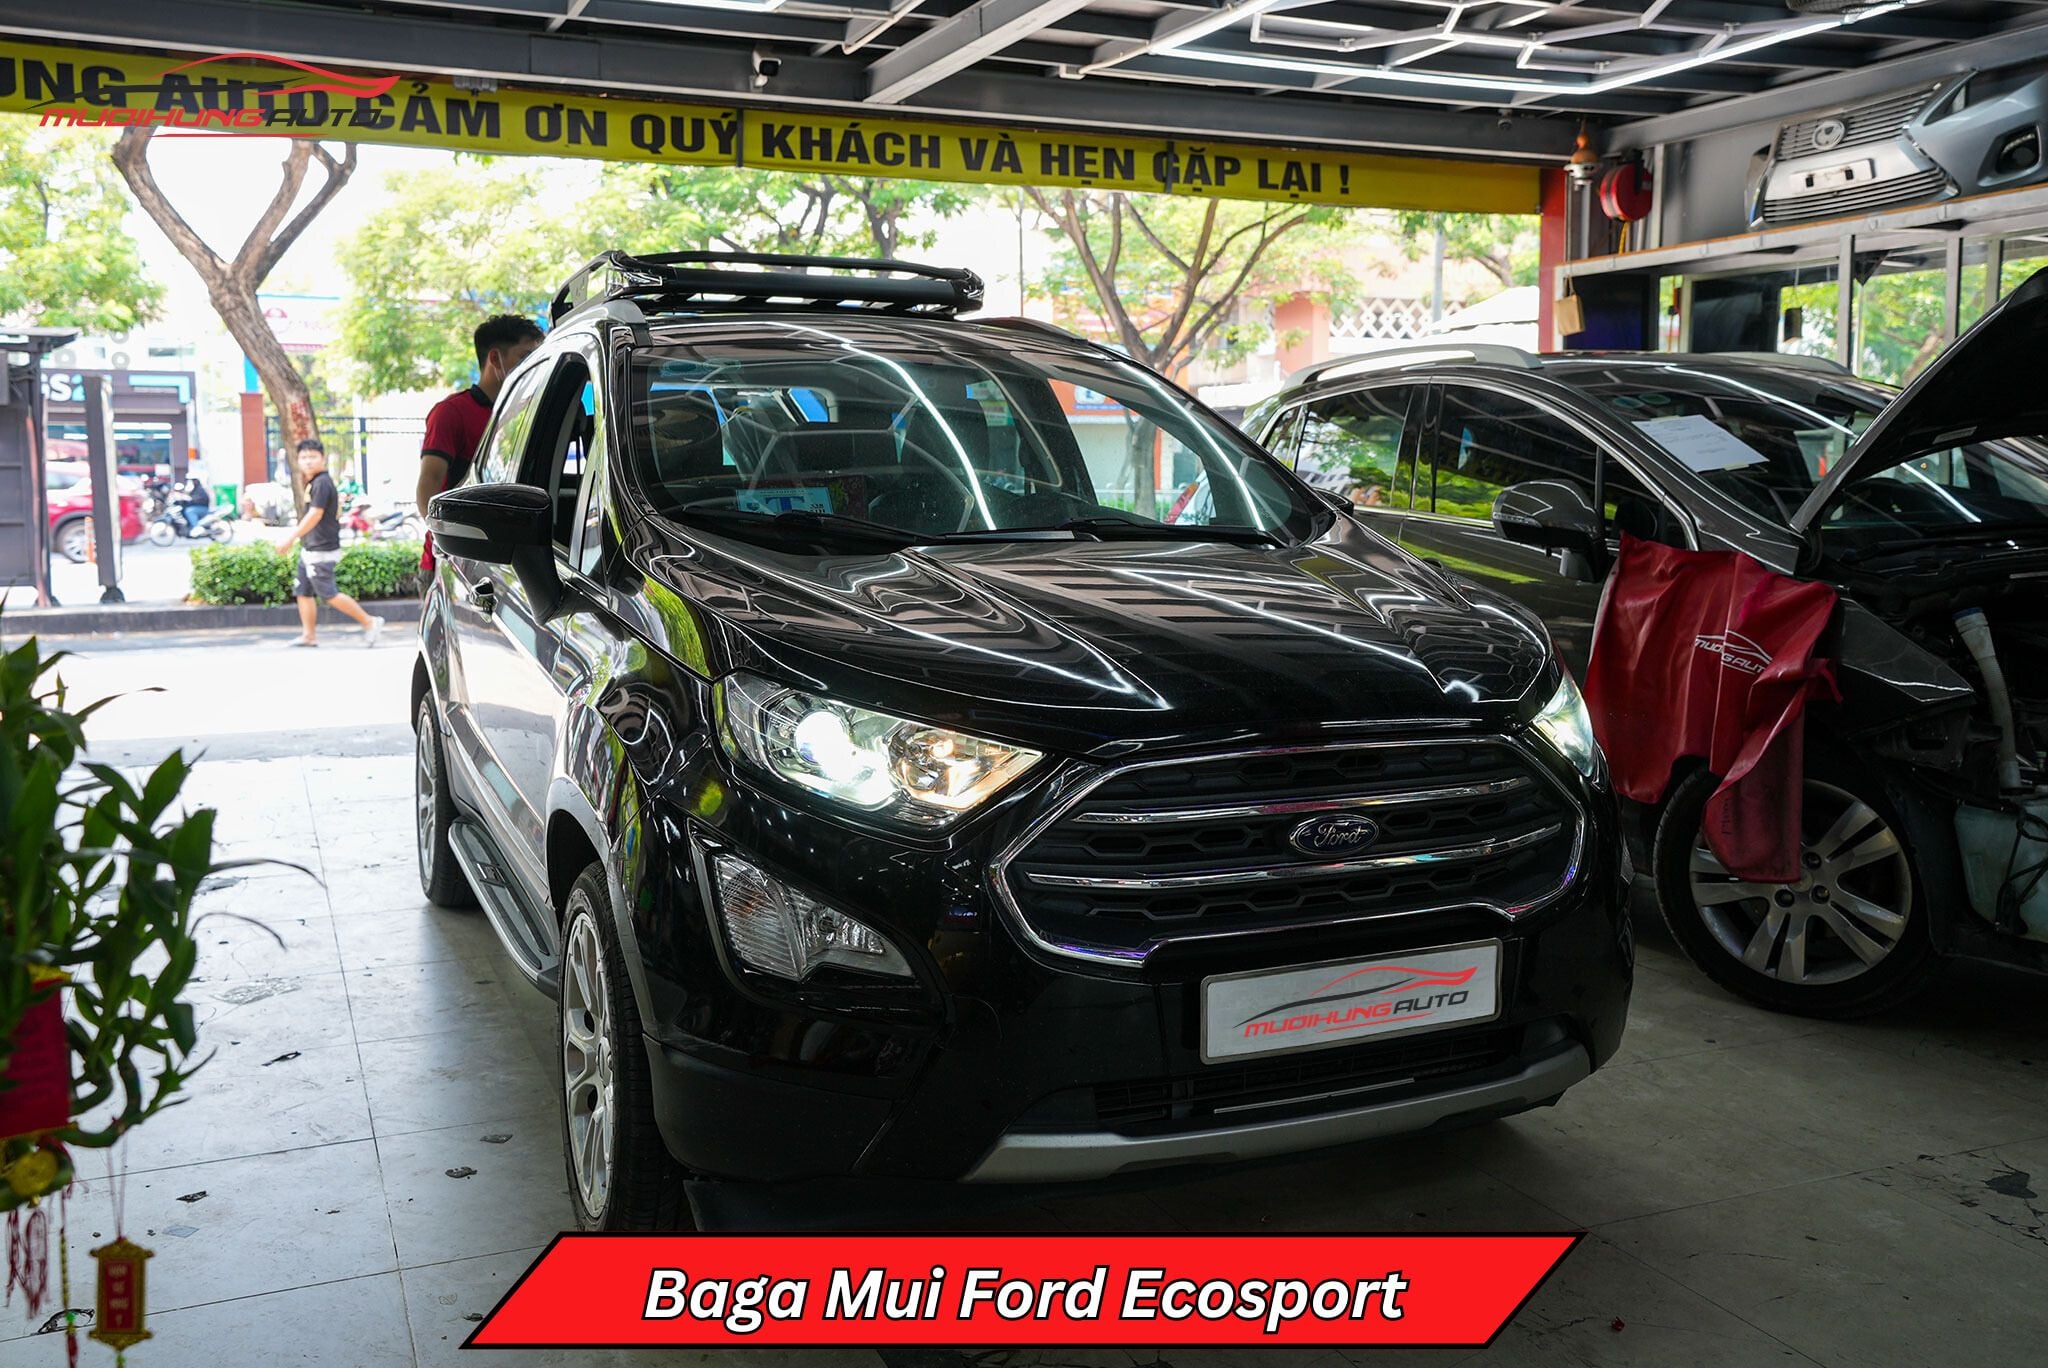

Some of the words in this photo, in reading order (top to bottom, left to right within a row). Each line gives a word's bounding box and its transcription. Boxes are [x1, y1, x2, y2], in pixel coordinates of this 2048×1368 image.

[154, 74, 329, 126] AUTO
[355, 81, 501, 138] CẢM
[525, 103, 608, 147] ƠN
[630, 112, 737, 155] QUÝ
[761, 122, 941, 169] KHÁCH
[959, 132, 1023, 174] VÀ
[1041, 143, 1135, 185] HẸN
[1153, 146, 1241, 192] GẶP
[1258, 159, 1321, 198] LẠI
[1314, 822, 1369, 847] Ford
